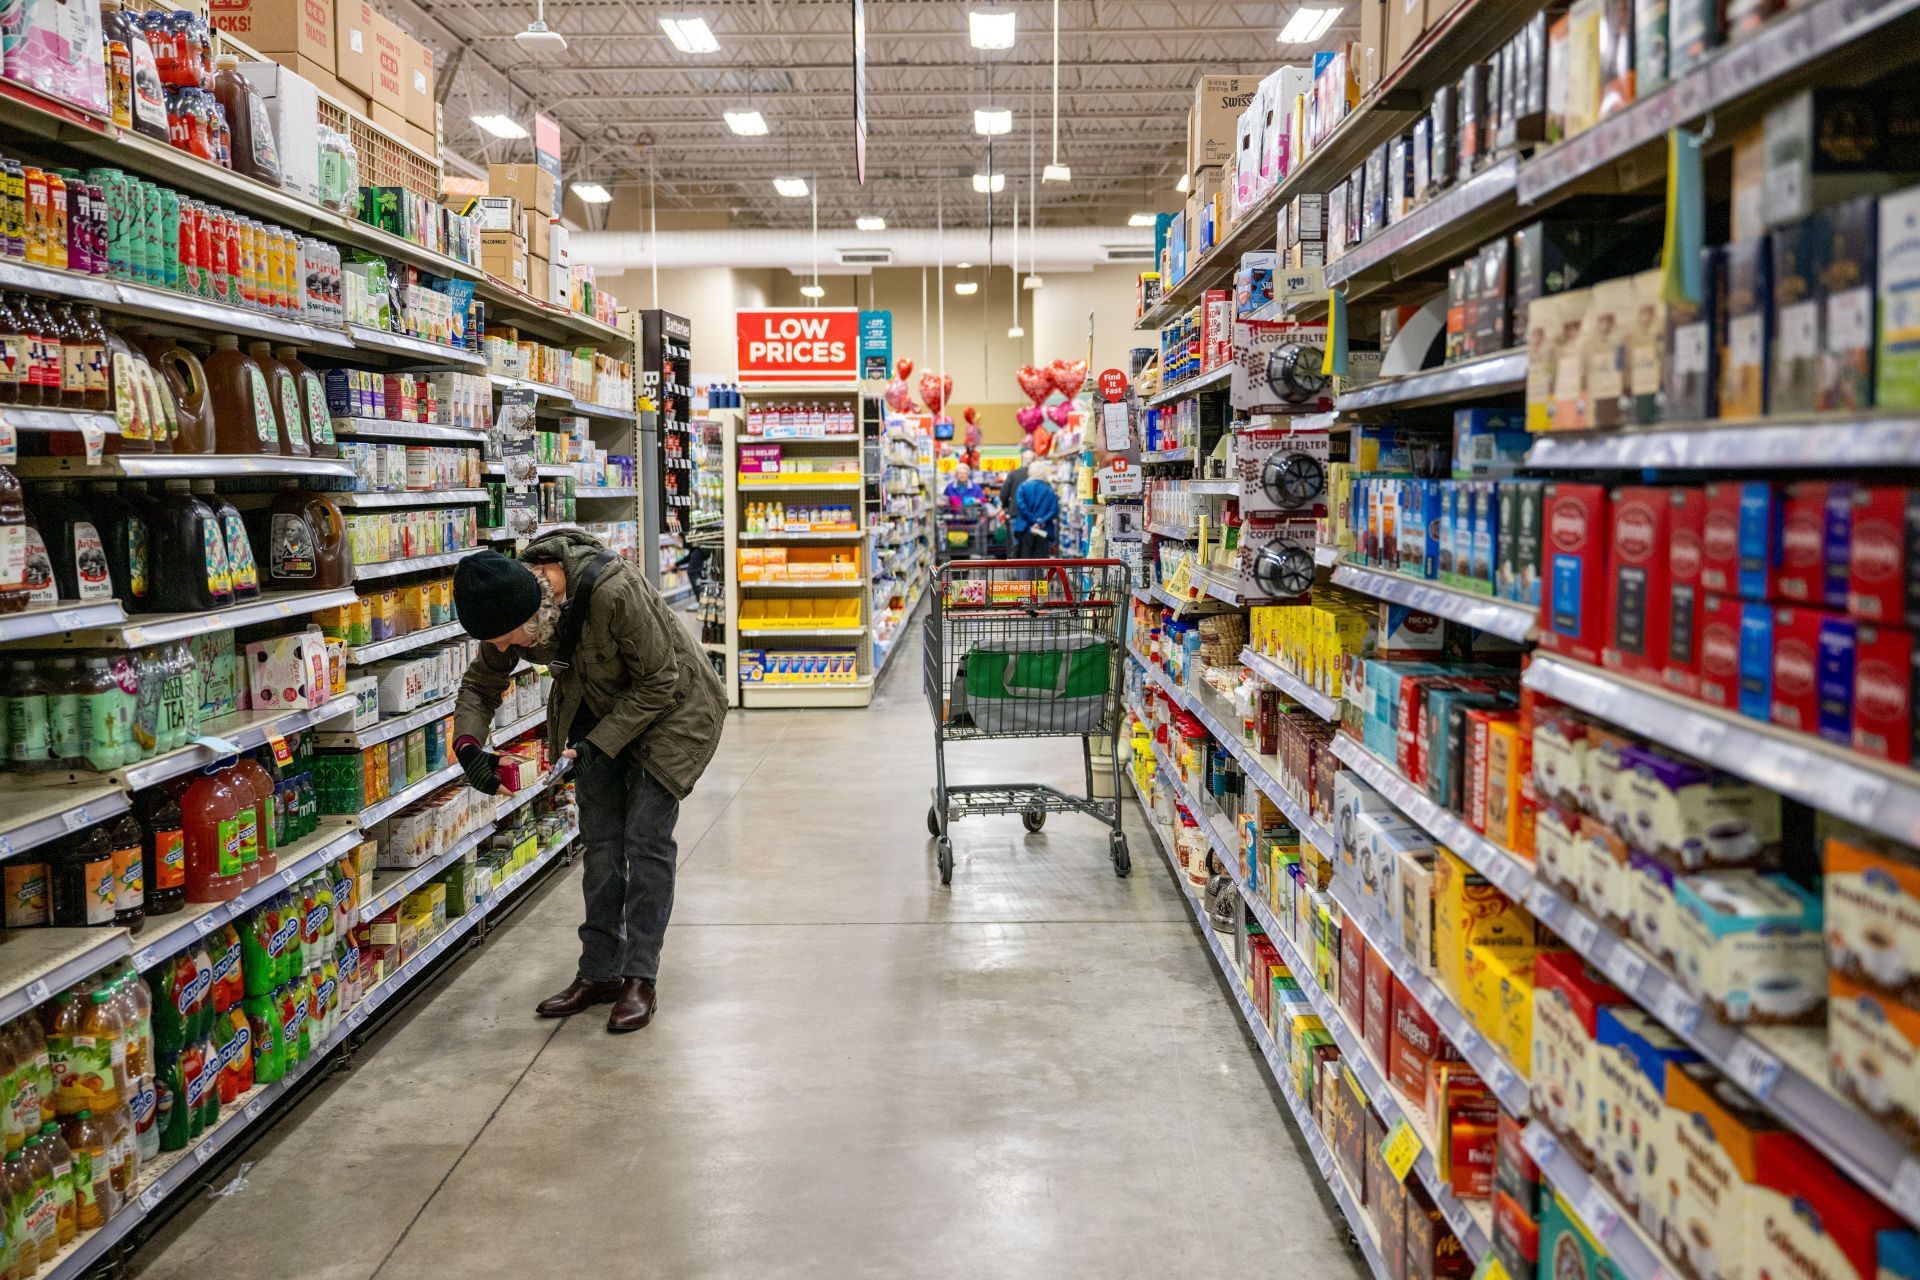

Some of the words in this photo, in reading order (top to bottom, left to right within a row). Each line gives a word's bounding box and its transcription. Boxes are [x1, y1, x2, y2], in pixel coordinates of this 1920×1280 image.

[306, 22, 328, 49] SNACKS!
[380, 73, 399, 97] SNACKS!
[665, 315, 690, 337] Batteries
[764, 318, 830, 340] LOW
[1260, 334, 1297, 343] COFFEE
[749, 341, 846, 363] PRICES
[1103, 374, 1121, 382] Find
[1105, 387, 1122, 395] Fast
[1254, 441, 1293, 450] COFFEE
[1298, 440, 1328, 450] FILTER
[1249, 529, 1286, 539] COFFEE
[1287, 529, 1317, 539] FILTER
[164, 700, 185, 730] TEA
[1397, 1007, 1430, 1053] Folgers
